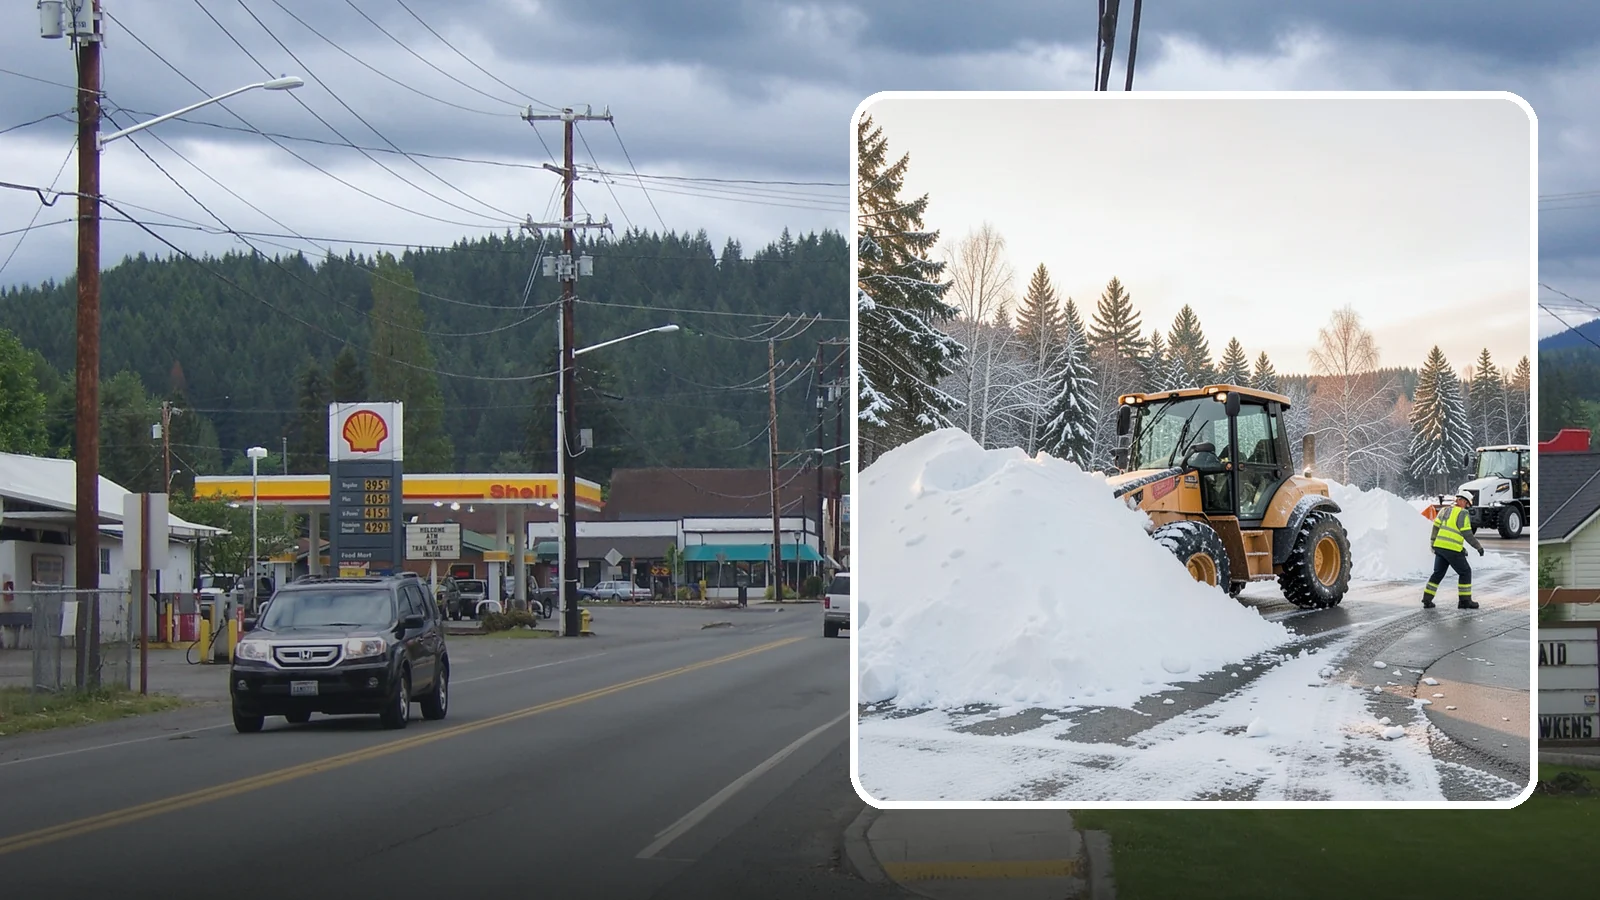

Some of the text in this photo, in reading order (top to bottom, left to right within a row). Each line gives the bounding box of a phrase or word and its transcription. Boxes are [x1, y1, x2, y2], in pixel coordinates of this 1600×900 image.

[366, 480, 383, 490] 395
[490, 484, 547, 499] Shell
[366, 494, 383, 504] 405
[366, 508, 383, 518] 415
[366, 522, 383, 532] 429
